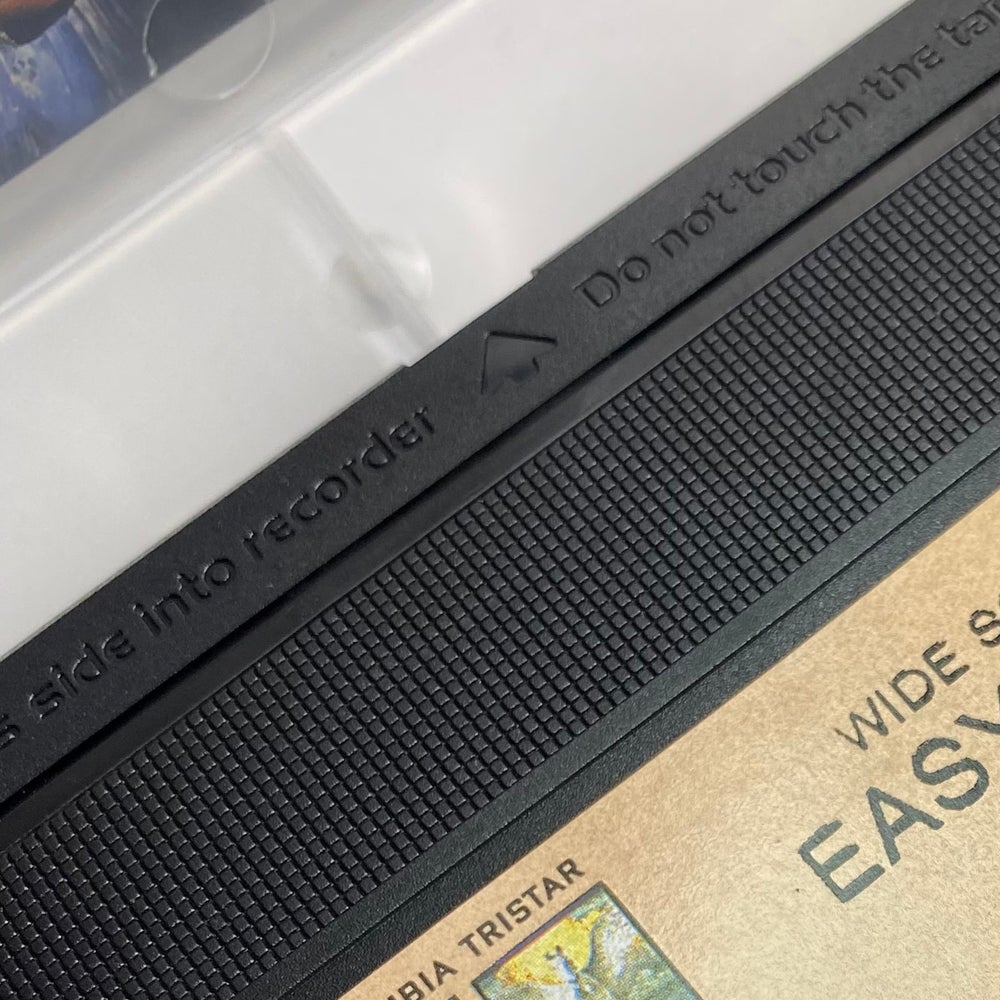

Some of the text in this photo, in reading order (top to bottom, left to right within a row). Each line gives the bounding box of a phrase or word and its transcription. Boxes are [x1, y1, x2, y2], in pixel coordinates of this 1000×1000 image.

[573, 256, 653, 309] Do
[652, 191, 739, 260] not
[732, 101, 868, 196] touch
[860, 44, 945, 102] the
[28, 406, 436, 719] side into recorder
[833, 640, 971, 751] WIDE
[458, 857, 586, 957] TRISTAR
